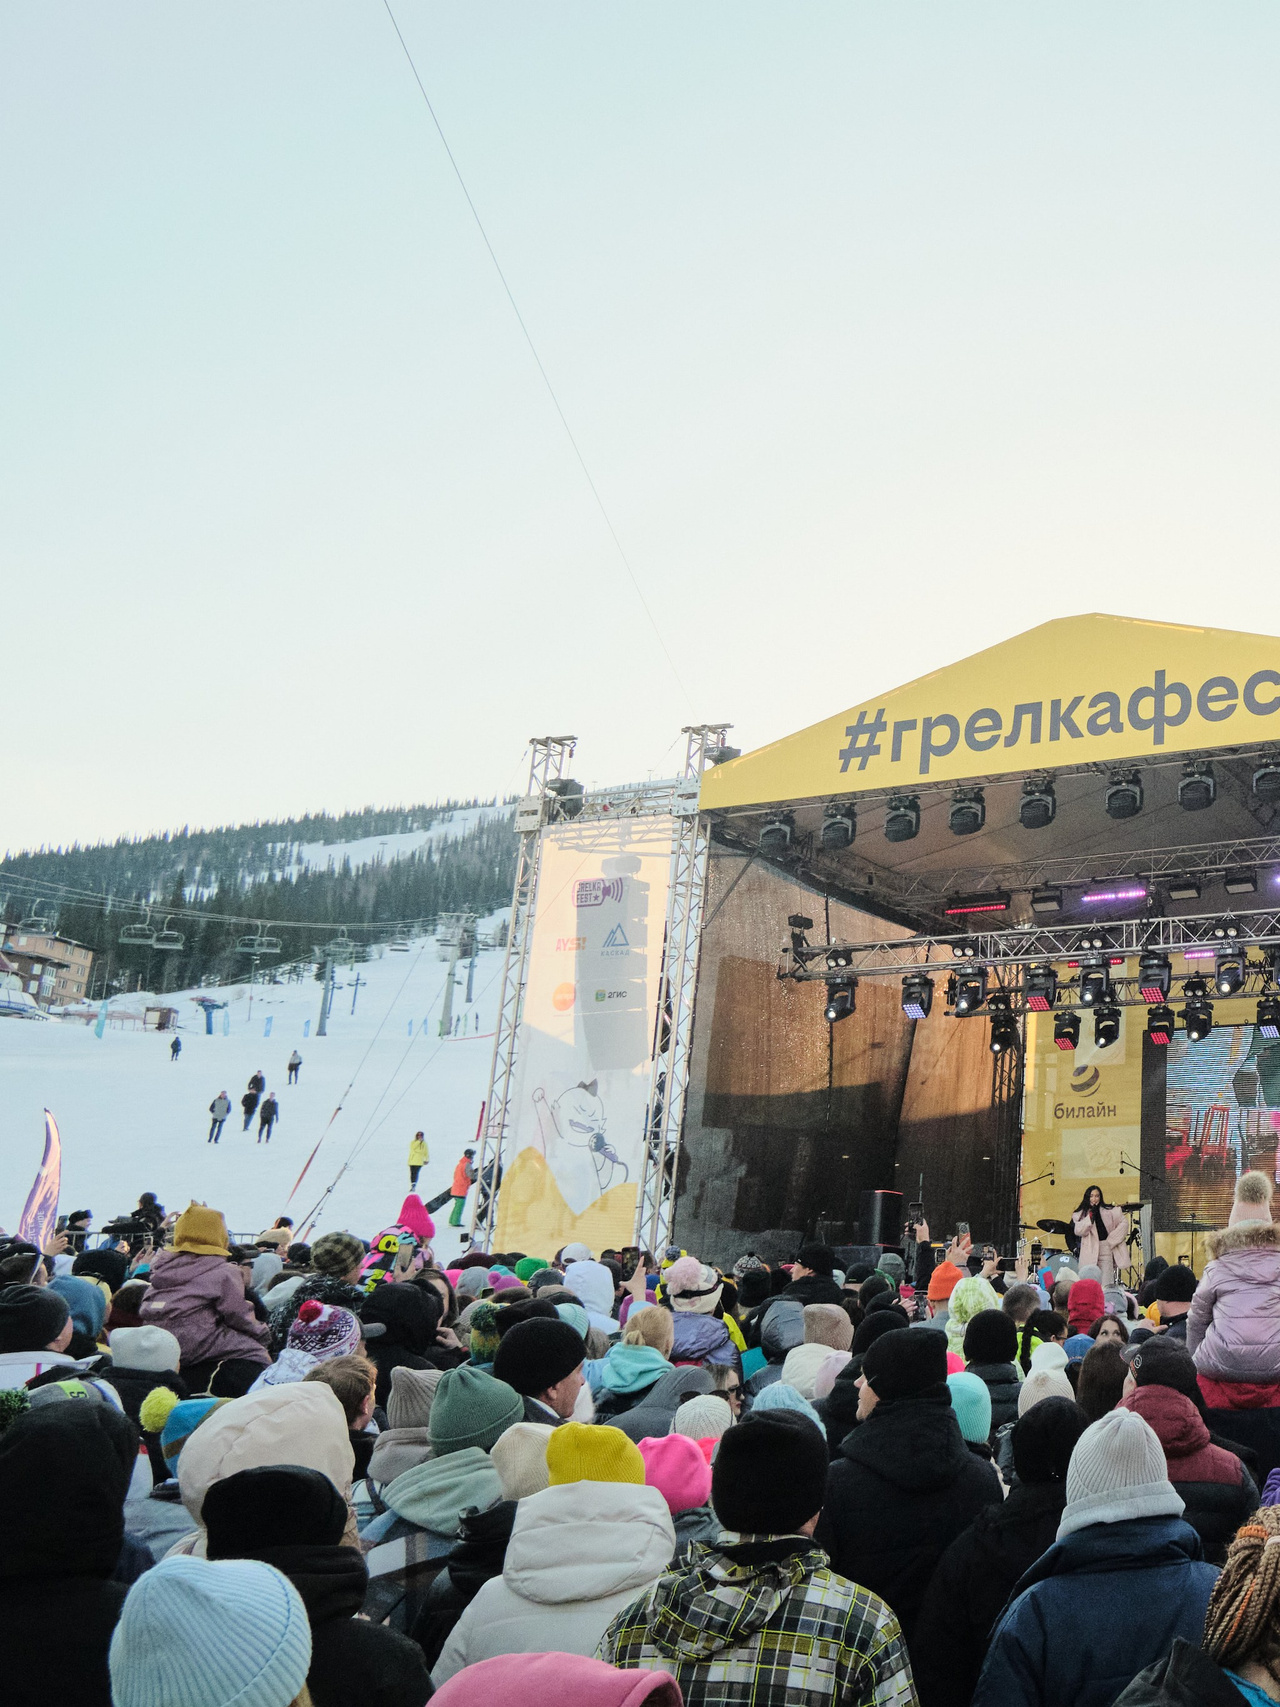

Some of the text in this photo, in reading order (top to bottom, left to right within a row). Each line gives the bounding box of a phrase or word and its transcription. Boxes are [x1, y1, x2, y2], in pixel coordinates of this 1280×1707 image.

[576, 893, 593, 903] FEST
[607, 990, 628, 999] 2ГИС
[1053, 1101, 1117, 1120] билайн
